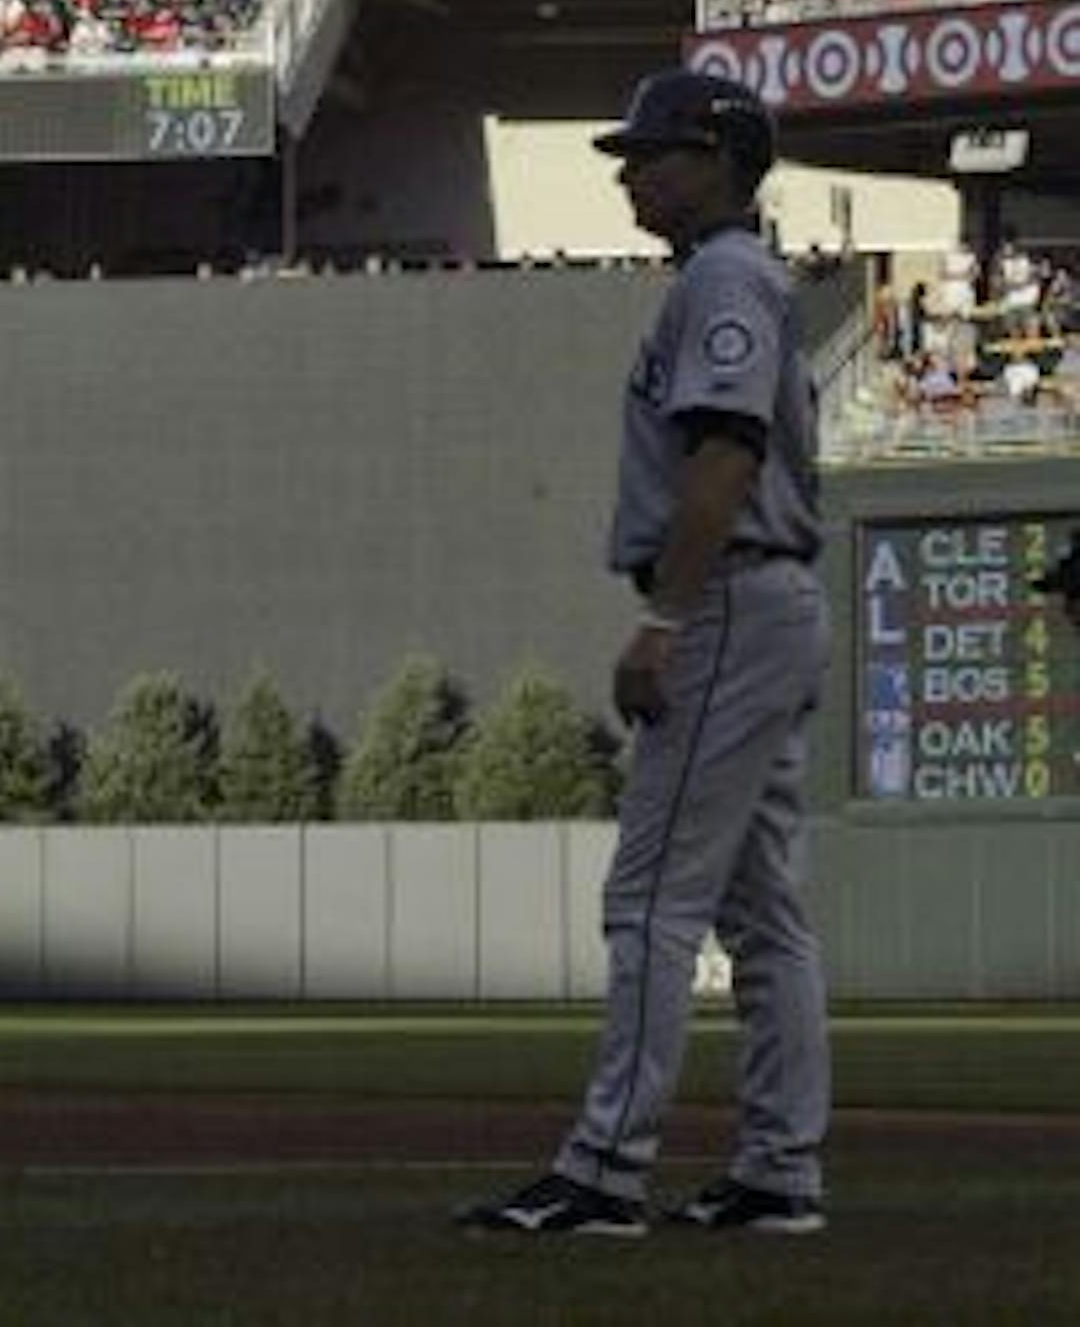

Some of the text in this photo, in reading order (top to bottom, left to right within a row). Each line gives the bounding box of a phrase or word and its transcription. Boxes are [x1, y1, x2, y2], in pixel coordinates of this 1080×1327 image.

[146, 76, 237, 108] TIME
[146, 109, 243, 151] 7:07
[921, 528, 1008, 565] CLE
[922, 572, 1008, 609] TOR
[924, 624, 1008, 661] DET
[924, 668, 1009, 703] BOS
[920, 721, 1013, 757] OAK
[915, 760, 1021, 799] CHW
